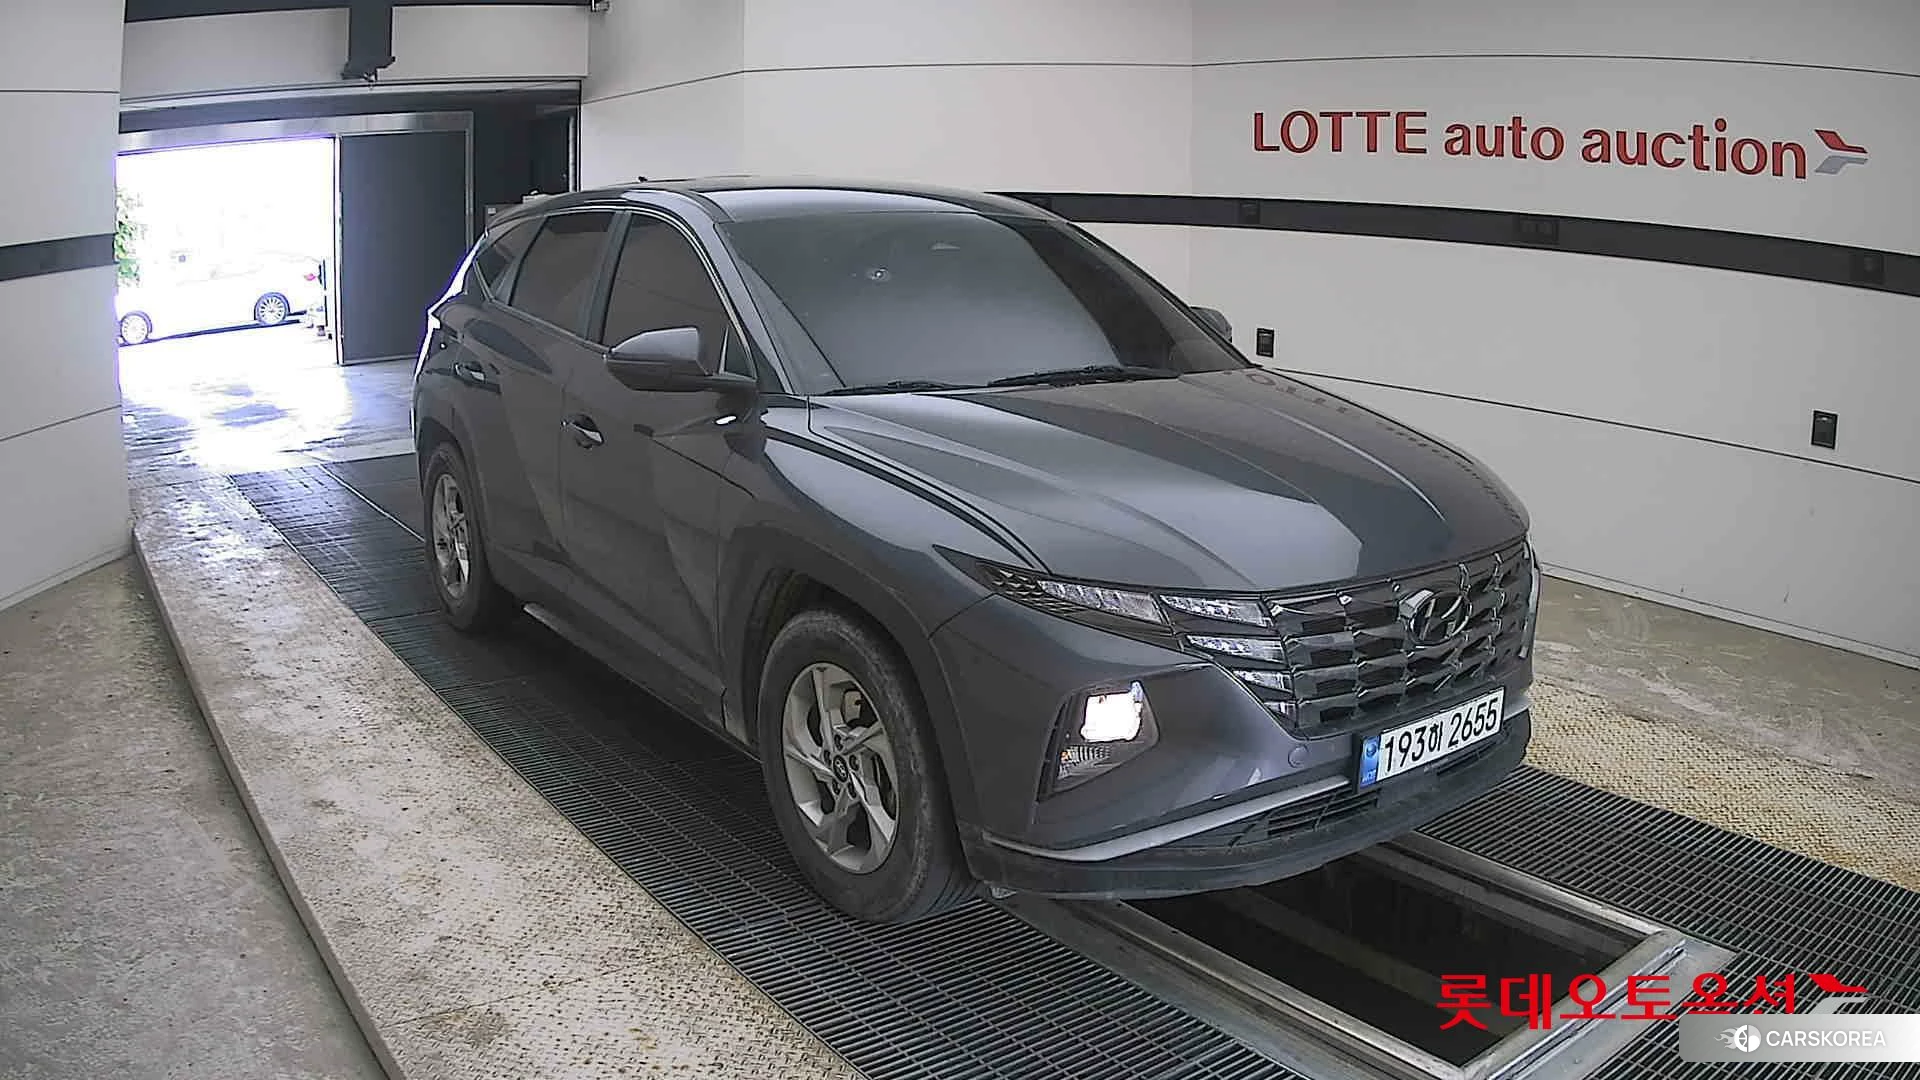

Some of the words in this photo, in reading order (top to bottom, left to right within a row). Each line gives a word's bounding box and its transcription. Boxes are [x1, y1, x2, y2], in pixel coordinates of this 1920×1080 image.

[1253, 111, 1428, 154] LOTTE
[1443, 115, 1566, 161] auto
[1580, 118, 1808, 180] auction
[1447, 697, 1499, 749] 2655
